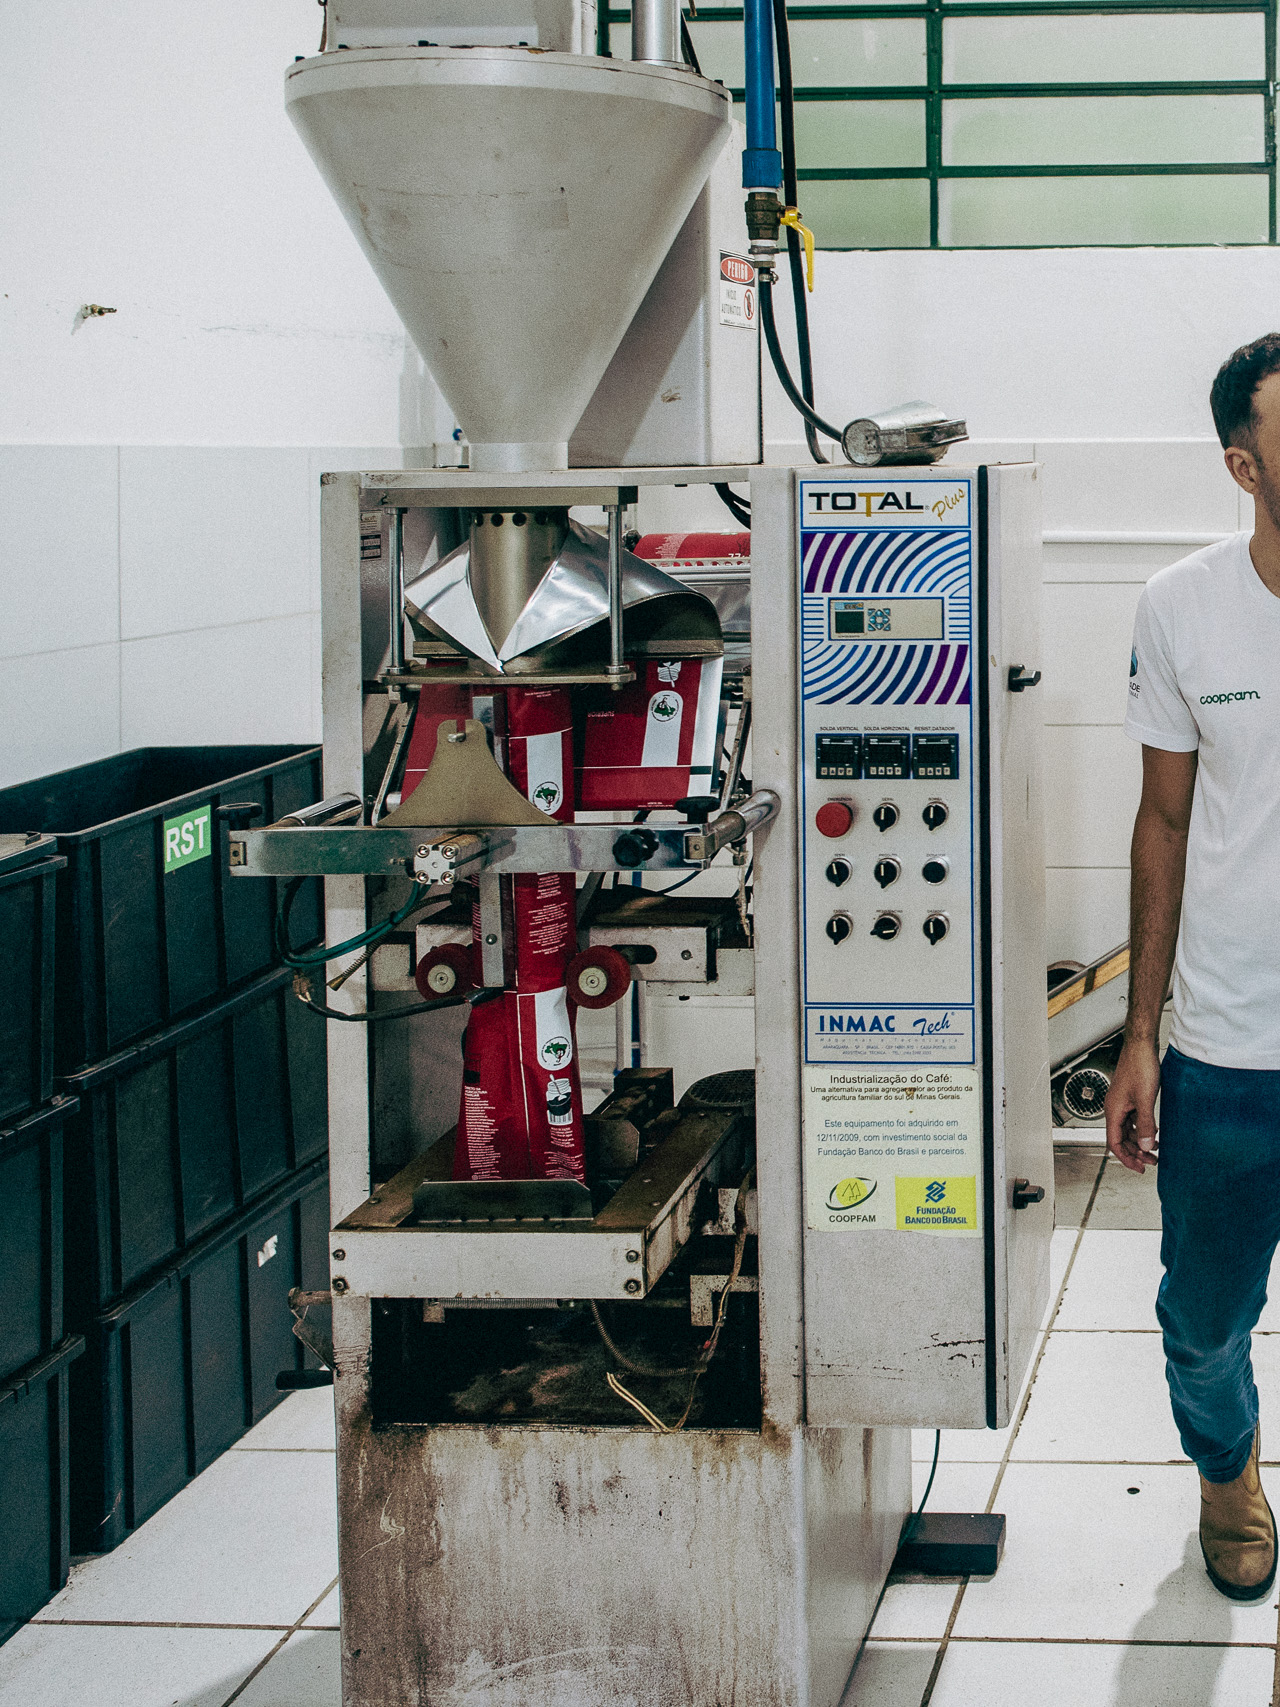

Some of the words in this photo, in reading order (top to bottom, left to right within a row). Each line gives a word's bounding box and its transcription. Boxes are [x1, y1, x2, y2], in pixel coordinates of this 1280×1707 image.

[727, 260, 748, 280] PERIGO
[808, 492, 924, 518] TOTAL
[932, 488, 966, 522] Plus
[1200, 690, 1260, 705] coopfam
[166, 815, 208, 863] RST
[820, 1015, 896, 1032] INMAC
[912, 1012, 951, 1036] Tech
[830, 1074, 908, 1086] Industrialização
[910, 1074, 923, 1083] do
[926, 1074, 952, 1083] Café:
[844, 1120, 894, 1129] equipamento
[896, 1119, 906, 1127] foi
[908, 1119, 944, 1128] adquirido
[816, 1133, 861, 1142] 12/11/2009,
[882, 1133, 931, 1141] investimento
[933, 1132, 955, 1140] social
[817, 1147, 856, 1157] Fundação
[928, 1147, 967, 1156] parceiros.
[916, 1206, 956, 1215] FUNDAÇÃO
[829, 1214, 876, 1223] COOPFAM
[905, 1216, 930, 1224] BANCO
[942, 1216, 967, 1224] BRASIL
